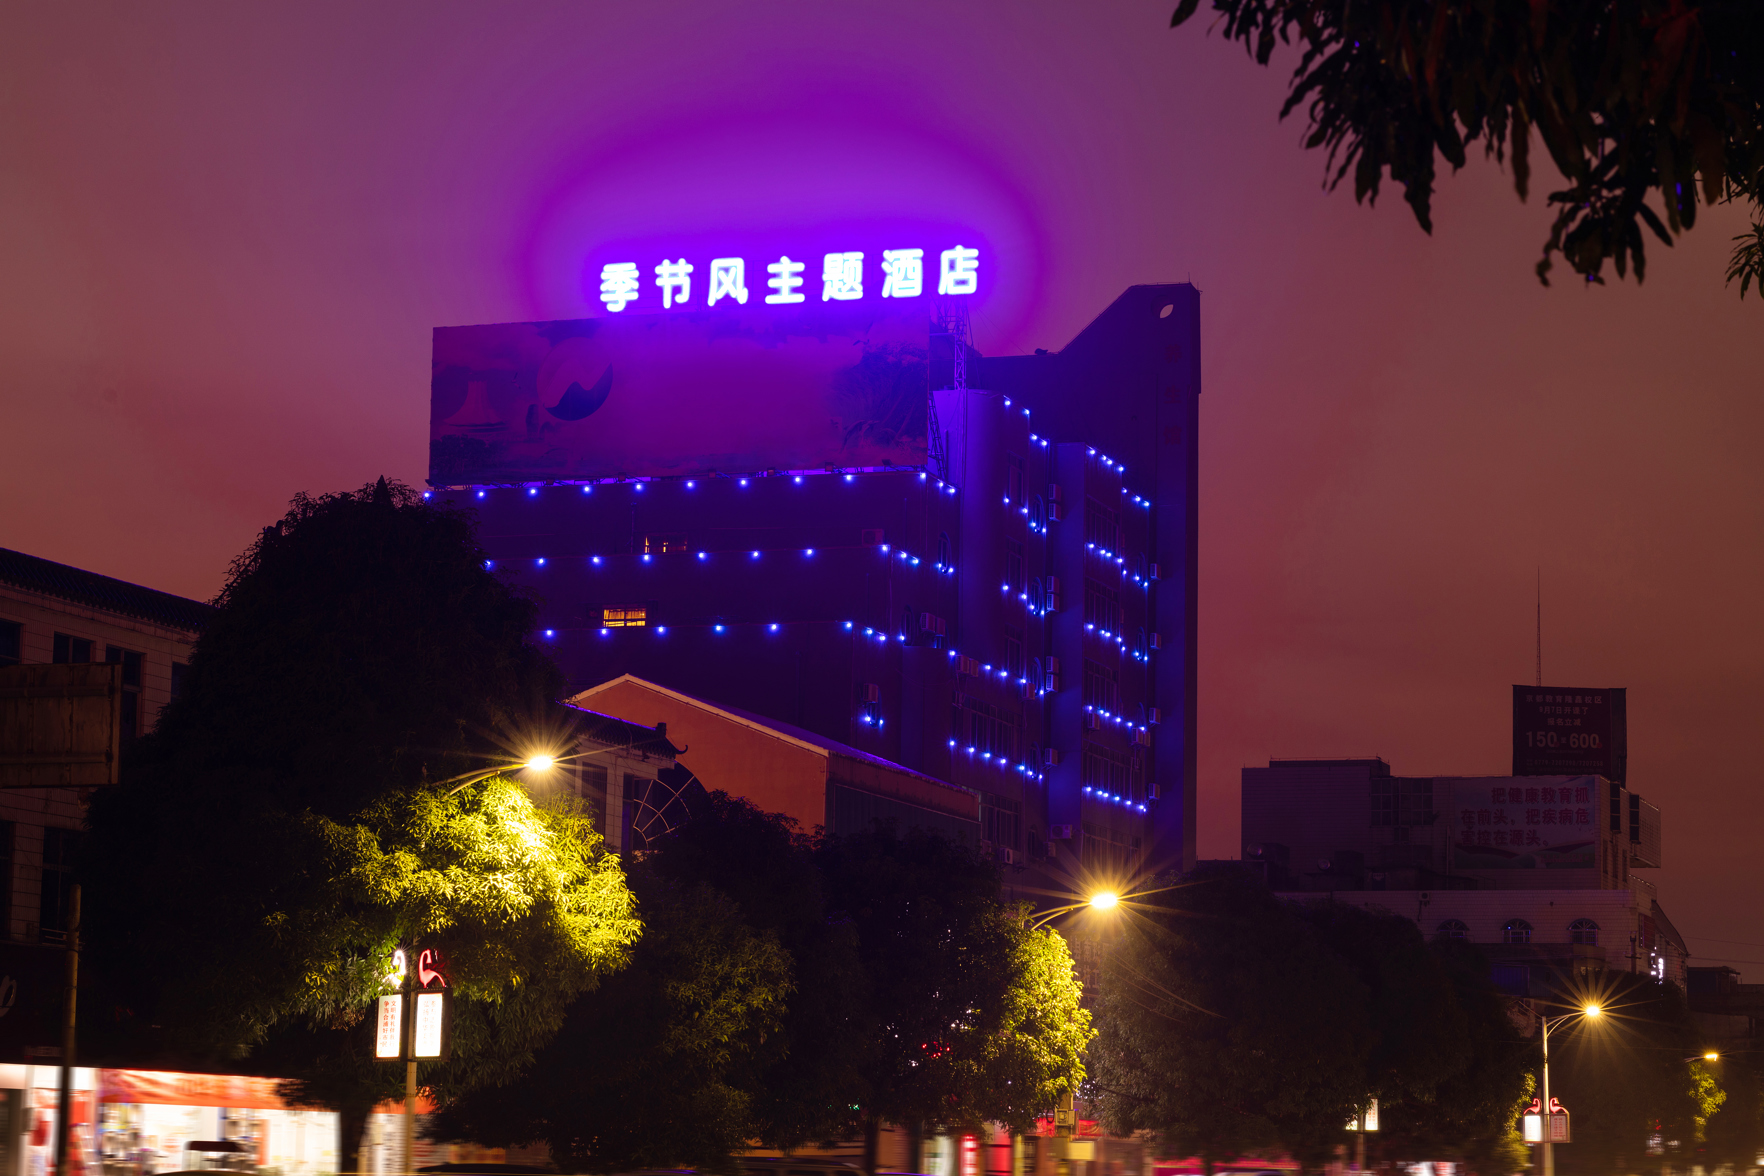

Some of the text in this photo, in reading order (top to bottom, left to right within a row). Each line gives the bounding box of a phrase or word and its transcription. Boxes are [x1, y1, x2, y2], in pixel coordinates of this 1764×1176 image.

[600, 245, 979, 312] 季节风主题酒店
[1525, 731, 1558, 748] 150
[1569, 733, 1600, 749] 600
[1491, 787, 1590, 804] 把健康教育抓
[1460, 807, 1590, 826] 在前头，把疾病危
[1461, 829, 1549, 847] 害控在源头。
